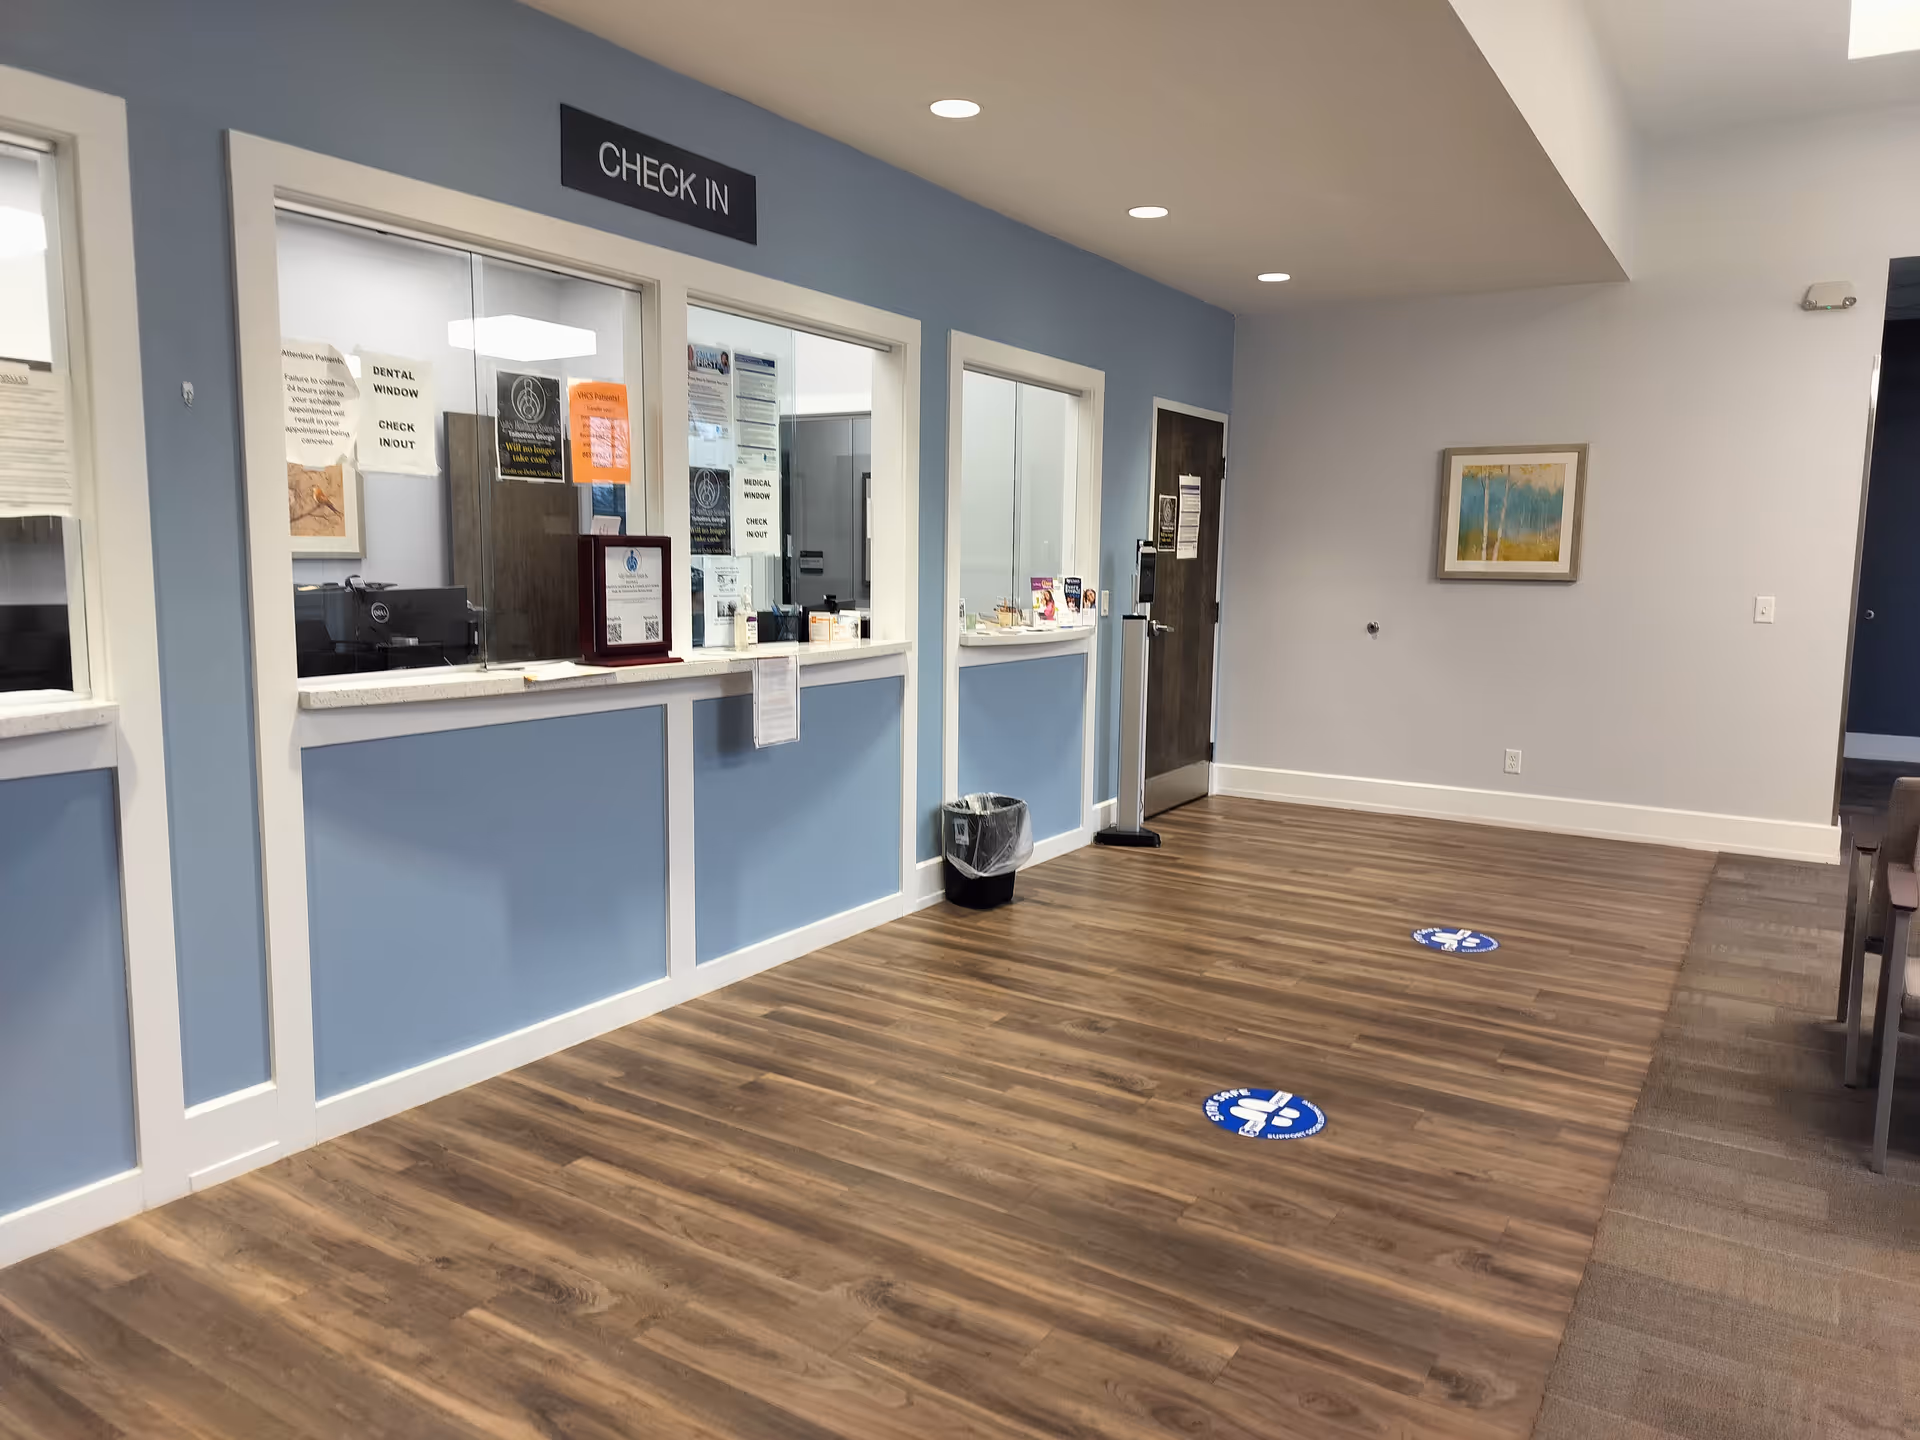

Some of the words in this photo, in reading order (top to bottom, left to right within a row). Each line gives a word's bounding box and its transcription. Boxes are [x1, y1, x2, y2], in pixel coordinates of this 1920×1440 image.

[599, 141, 698, 205] CHECK
[705, 177, 729, 216] IN
[310, 376, 318, 384] to
[373, 366, 415, 381] DENTAL
[287, 384, 296, 392] 24
[373, 383, 418, 398] WINDOW
[379, 420, 415, 433] CHECK
[379, 437, 415, 450] IN/OUT
[505, 441, 521, 452] Will
[522, 445, 533, 453] no
[533, 444, 556, 457] longer
[744, 478, 771, 487] MEDICAL
[744, 491, 771, 500] WINDOW
[746, 517, 768, 525] CHECK
[1213, 1087, 1251, 1102] SAFE
[1205, 1099, 1225, 1121] STAY
